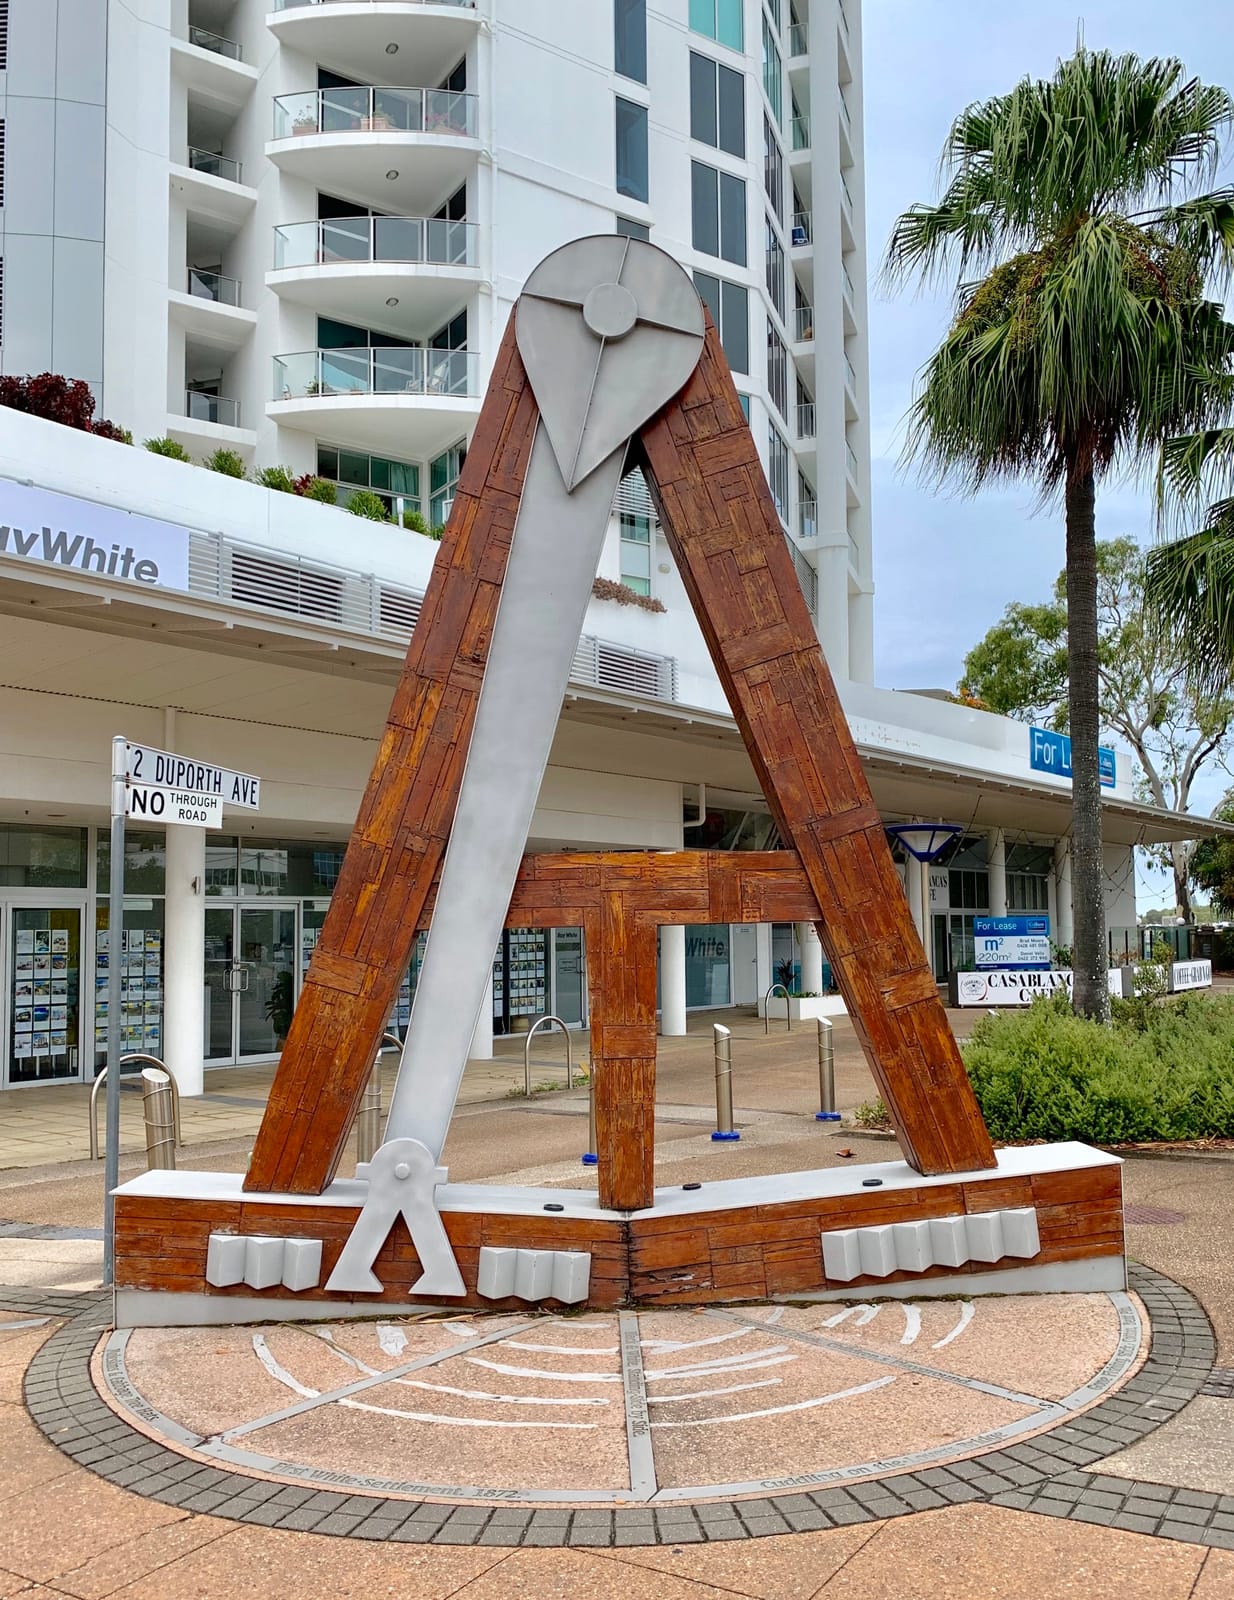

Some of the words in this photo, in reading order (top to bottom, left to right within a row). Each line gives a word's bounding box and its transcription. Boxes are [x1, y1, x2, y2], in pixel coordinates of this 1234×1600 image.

[1035, 732, 1057, 765] For
[133, 749, 143, 778] 2
[155, 755, 222, 793] DUPORTH
[231, 776, 258, 806] AVE
[132, 788, 165, 815] NO
[170, 793, 217, 809] THROUGH
[178, 808, 207, 822] ROAD
[977, 922, 991, 930] For
[993, 922, 1017, 930] Lease
[270, 1462, 308, 1475] First
[311, 1468, 357, 1486] White
[760, 1471, 843, 1490] Cuddling
[848, 1465, 871, 1476] on
[875, 1461, 902, 1473] the
